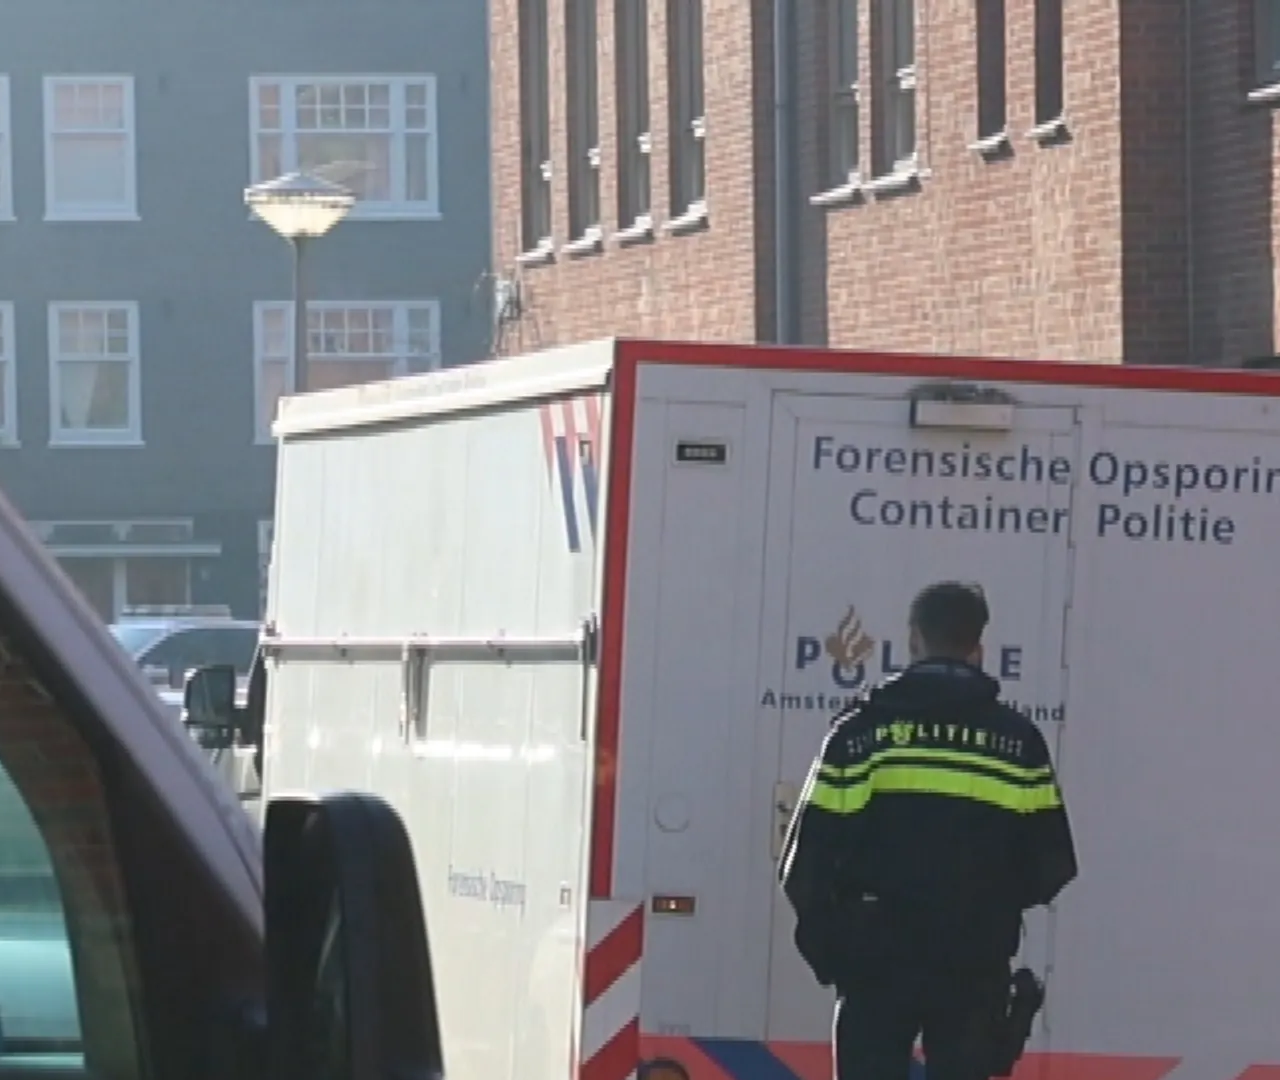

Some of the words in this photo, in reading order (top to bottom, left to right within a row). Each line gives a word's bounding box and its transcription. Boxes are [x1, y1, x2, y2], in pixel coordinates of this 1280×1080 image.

[814, 435, 1071, 485] Forensische
[849, 488, 1070, 534] Container
[1096, 503, 1236, 546] Politie
[796, 634, 1022, 690] POLE
[875, 720, 988, 746] POLITIE
